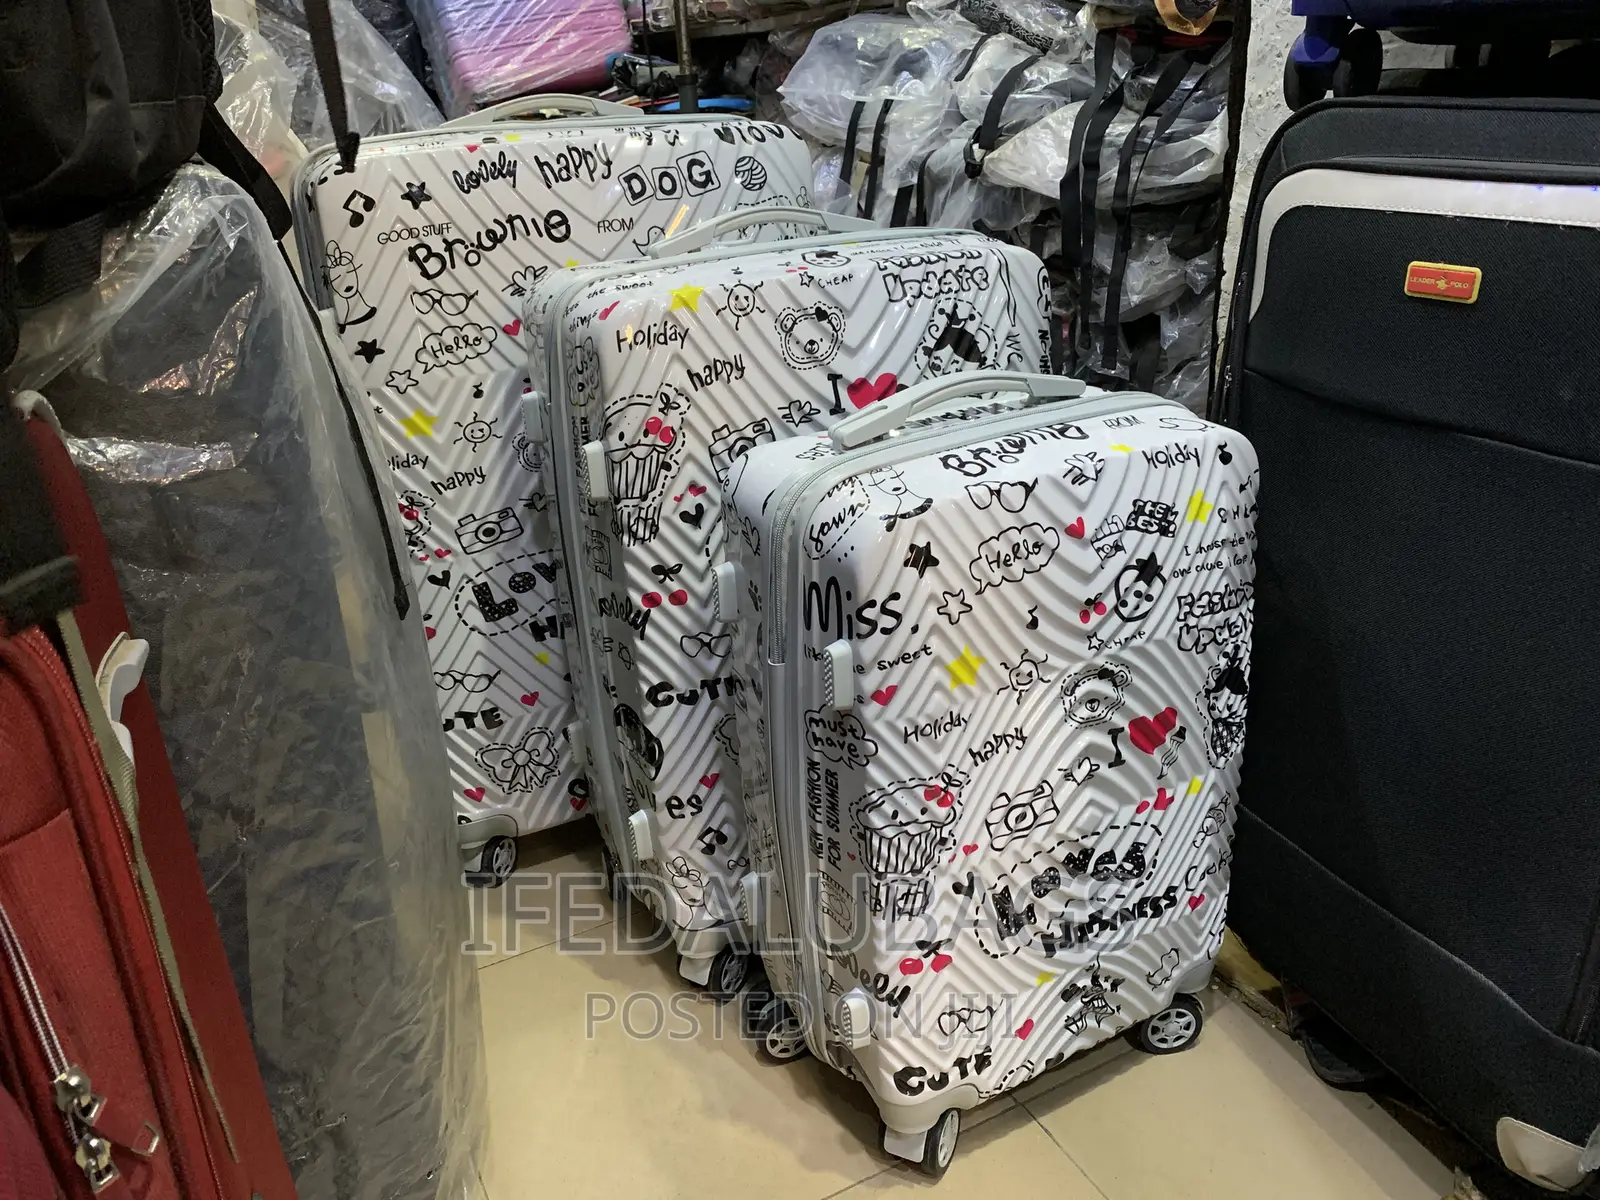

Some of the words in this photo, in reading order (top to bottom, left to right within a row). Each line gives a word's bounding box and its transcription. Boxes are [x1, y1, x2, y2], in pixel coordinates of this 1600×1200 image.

[534, 143, 613, 189] happy
[622, 157, 714, 201] DOG
[377, 227, 420, 245] GOOD
[422, 222, 453, 237] STUFF
[597, 217, 634, 234] FROM
[1410, 276, 1435, 285] LEADER
[1450, 281, 1469, 289] POLO
[431, 335, 483, 359] Hello
[616, 321, 690, 353] Holiday
[686, 354, 746, 392] happy
[387, 452, 429, 471] liday
[430, 466, 487, 495] happy
[986, 540, 1044, 573] Hello
[471, 562, 557, 622] LOV
[809, 716, 860, 741] must
[903, 711, 972, 744] Holiday
[812, 732, 860, 758] have
[968, 727, 1028, 767] happy
[807, 756, 822, 824] FASHION
[825, 768, 840, 833] SUMMER
[809, 825, 823, 859] NEW
[827, 836, 842, 872] FOR
[893, 1046, 993, 1096] CUTE
